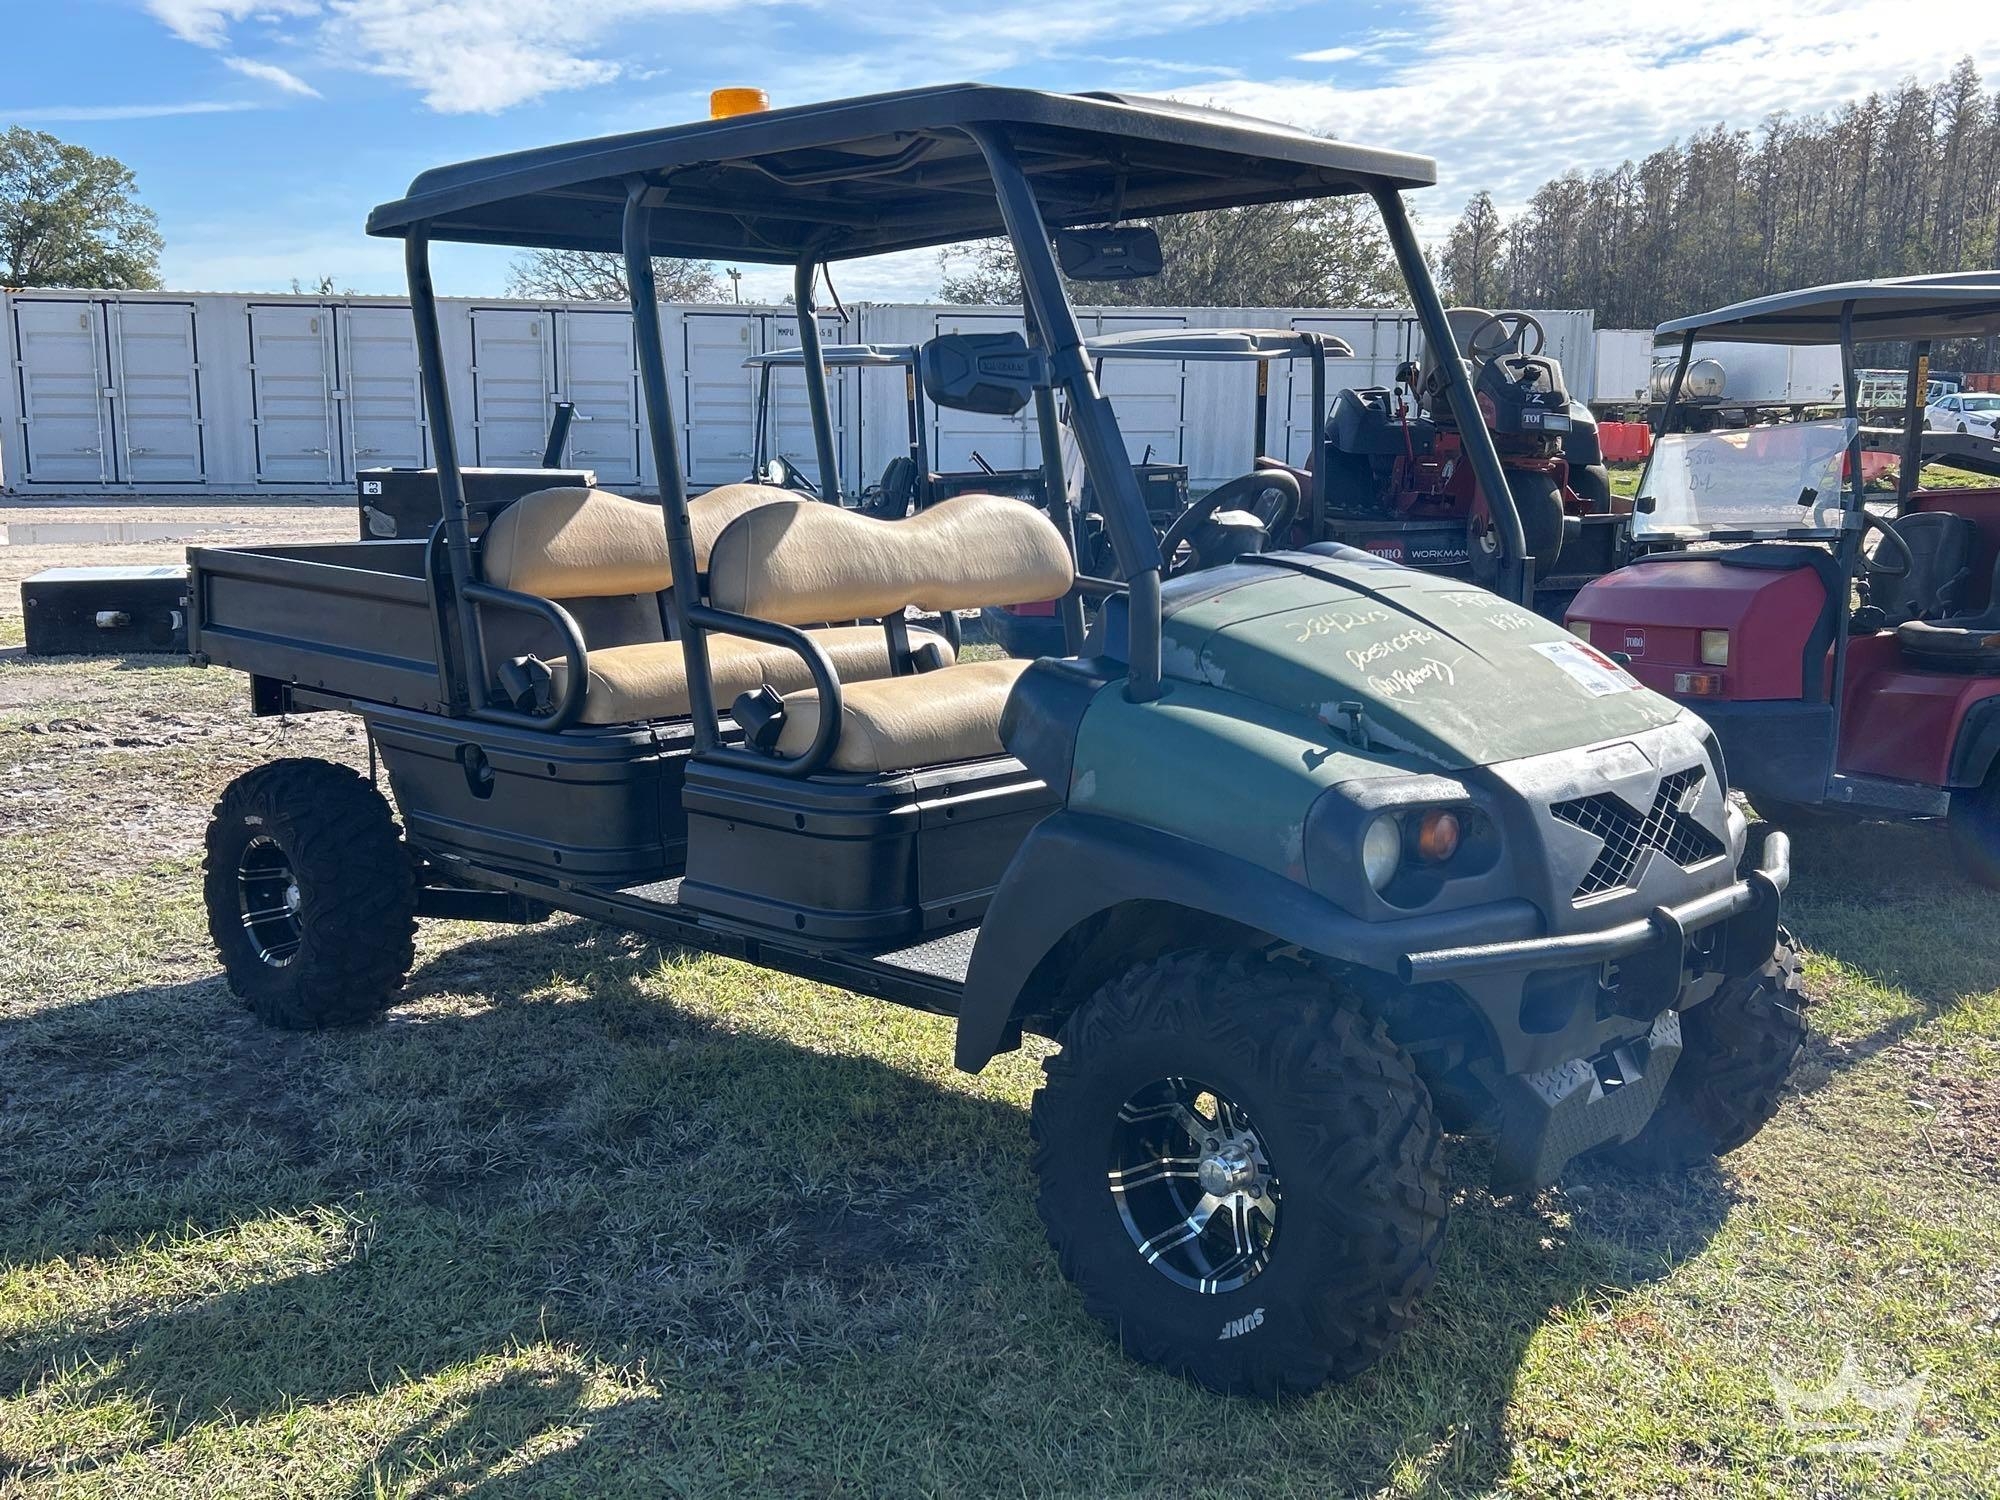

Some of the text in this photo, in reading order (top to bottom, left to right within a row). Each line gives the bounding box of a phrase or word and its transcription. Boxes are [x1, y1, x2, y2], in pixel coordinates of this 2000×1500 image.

[1523, 414, 1541, 424] TO
[1411, 549, 1469, 559] WORKMAN
[1625, 636, 1644, 648] TORO
